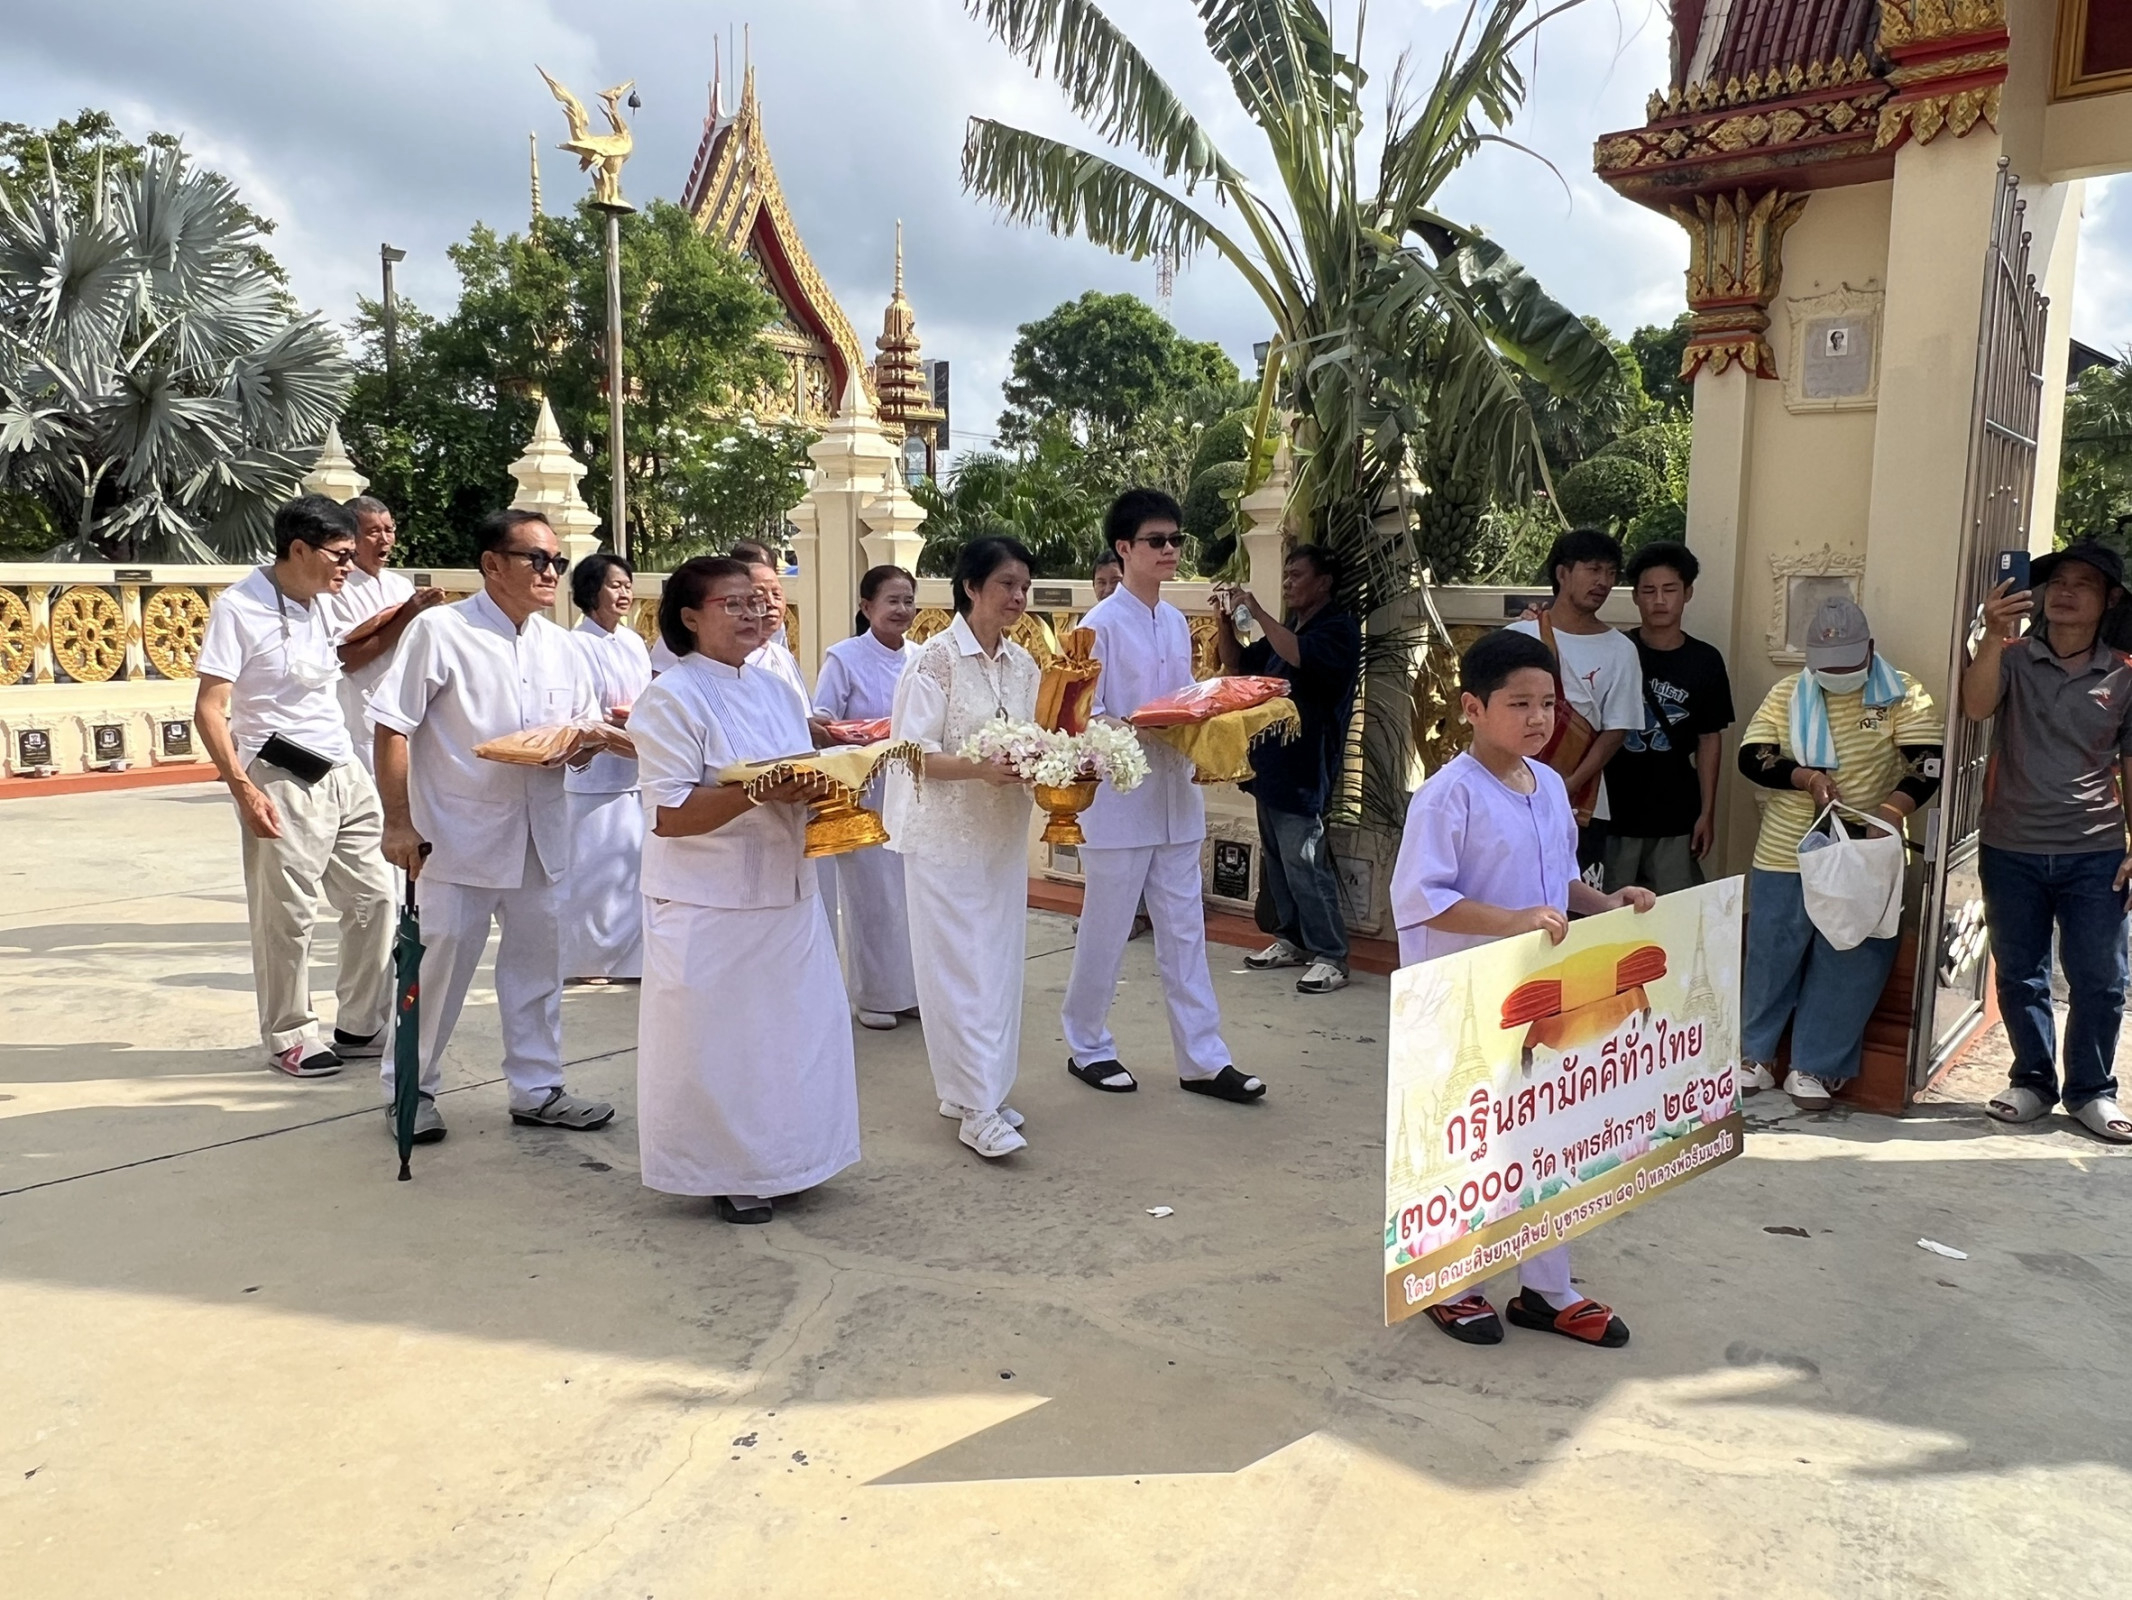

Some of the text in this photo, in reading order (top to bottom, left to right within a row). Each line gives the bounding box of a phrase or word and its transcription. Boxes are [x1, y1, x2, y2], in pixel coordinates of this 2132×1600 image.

[1402, 1066, 1733, 1239] ๓๐,๐๐๐ วัด พุทธศักราช ๒๕๖๘
[1447, 1018, 1702, 1162] กฐินสามัคคีทั่วไทย
[1405, 1276, 1435, 1304] โดย
[1553, 1192, 1613, 1238] บูชาธรรม
[1636, 1170, 1646, 1192] ปี
